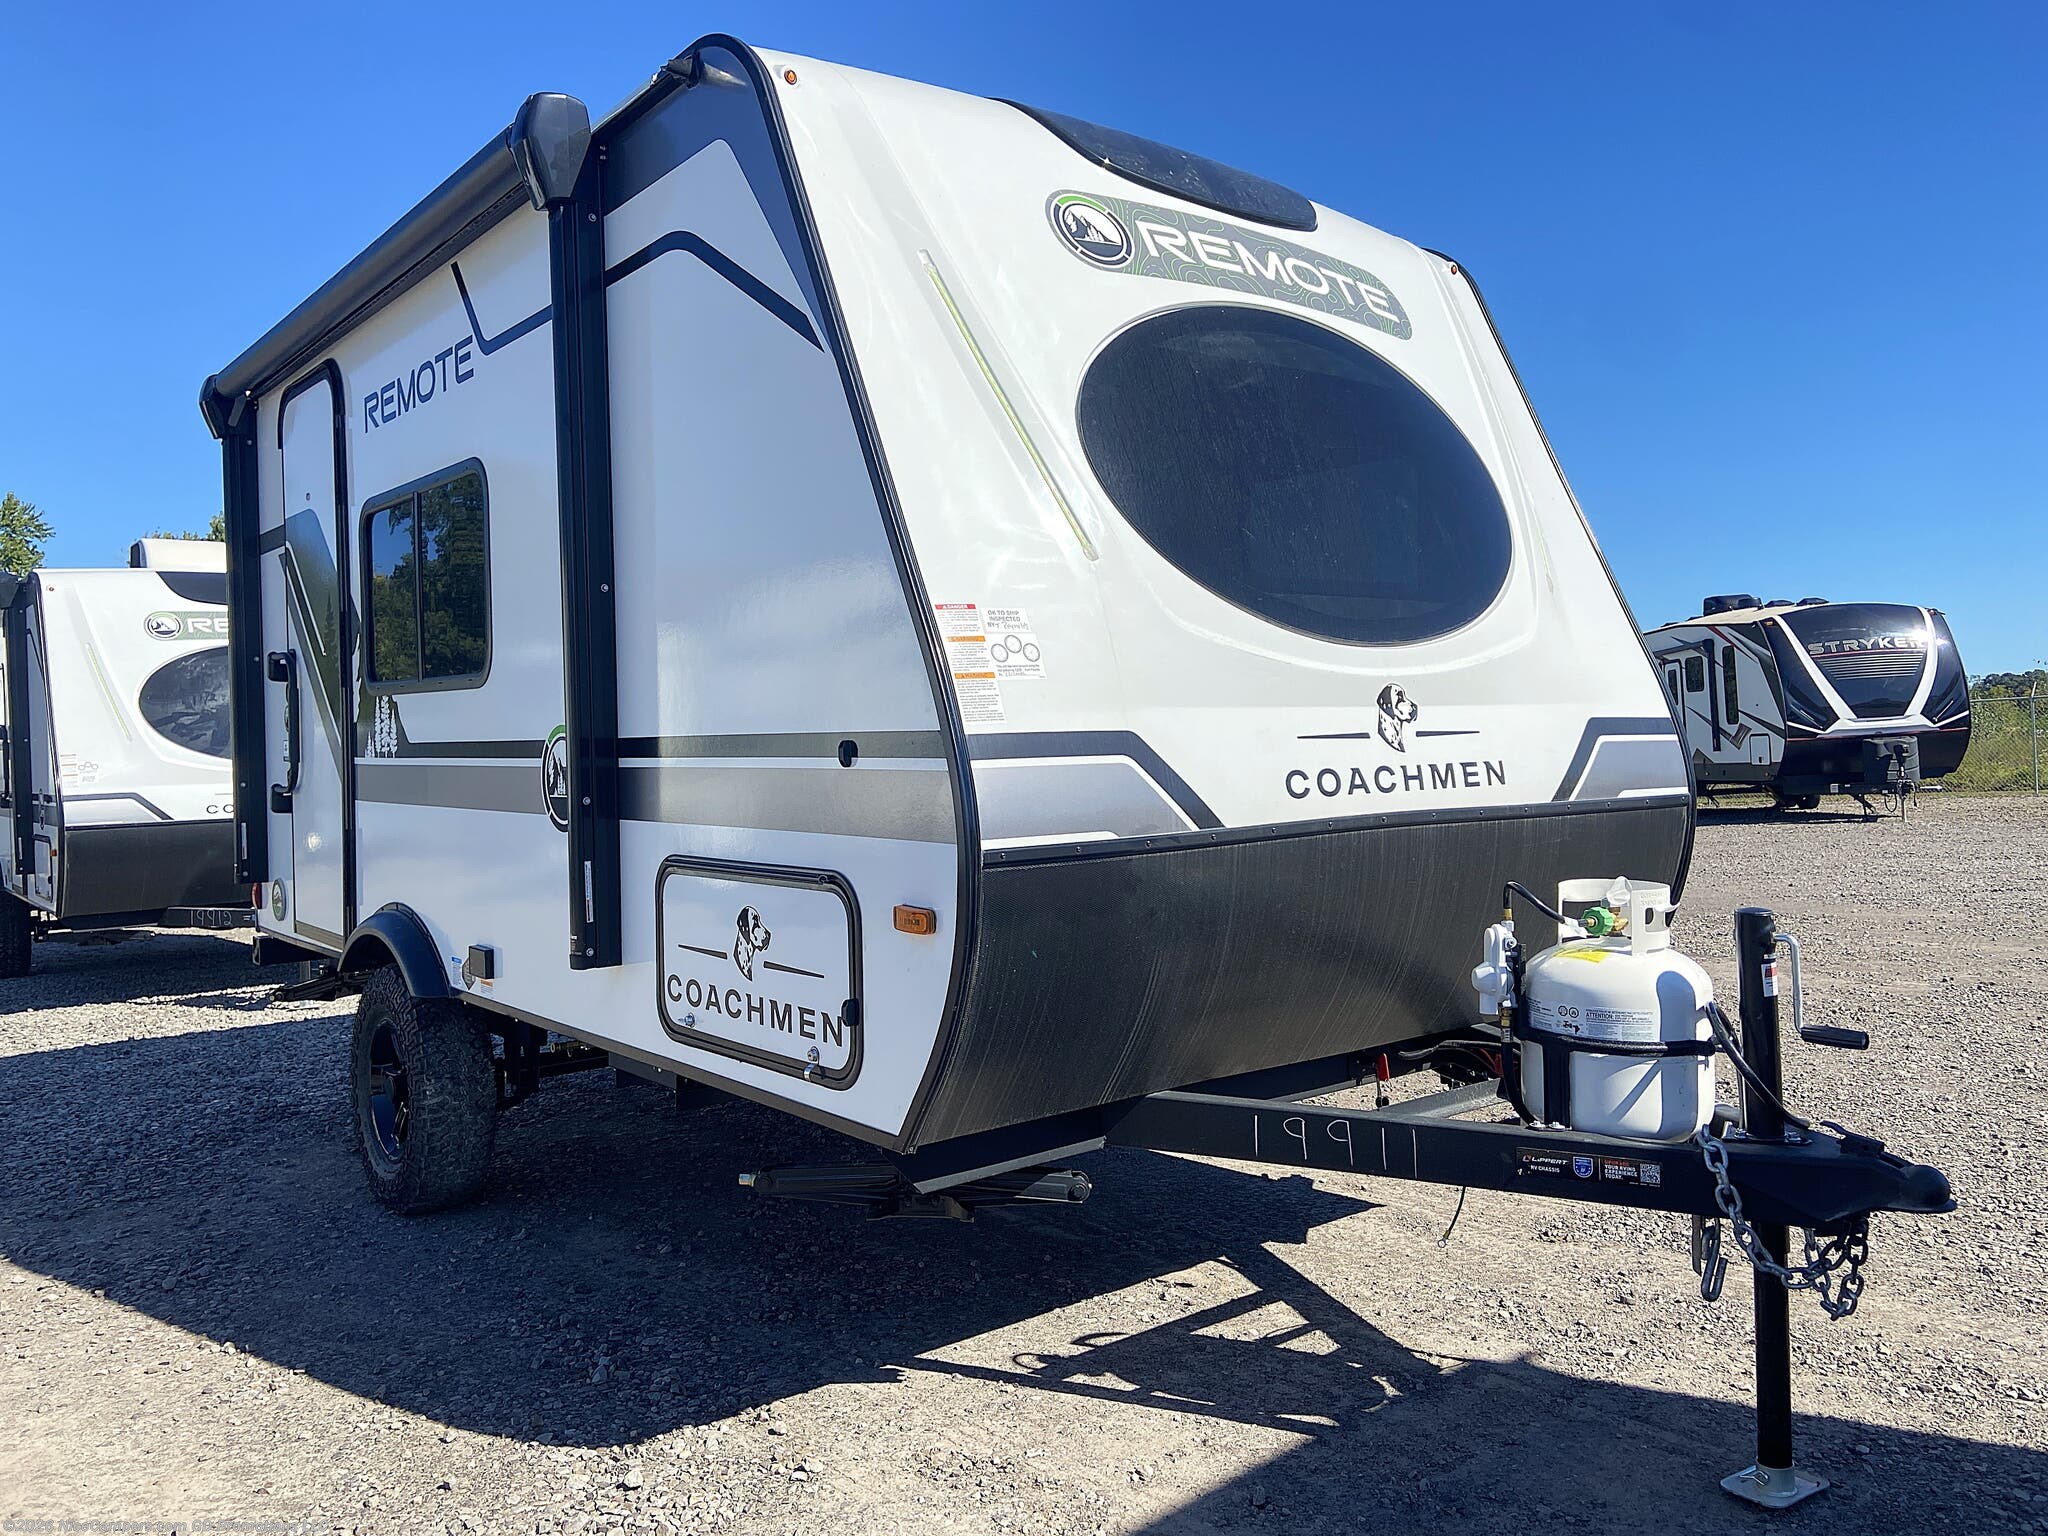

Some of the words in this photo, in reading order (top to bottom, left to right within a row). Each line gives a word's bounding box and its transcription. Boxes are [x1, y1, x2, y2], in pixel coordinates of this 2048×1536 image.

[1134, 218, 1401, 323] REMOTE
[363, 333, 475, 434] REMOTE
[1285, 760, 1506, 800] COACHMEN
[667, 973, 843, 1048] COACHMEN
[1254, 1114, 1418, 1179] 19911
